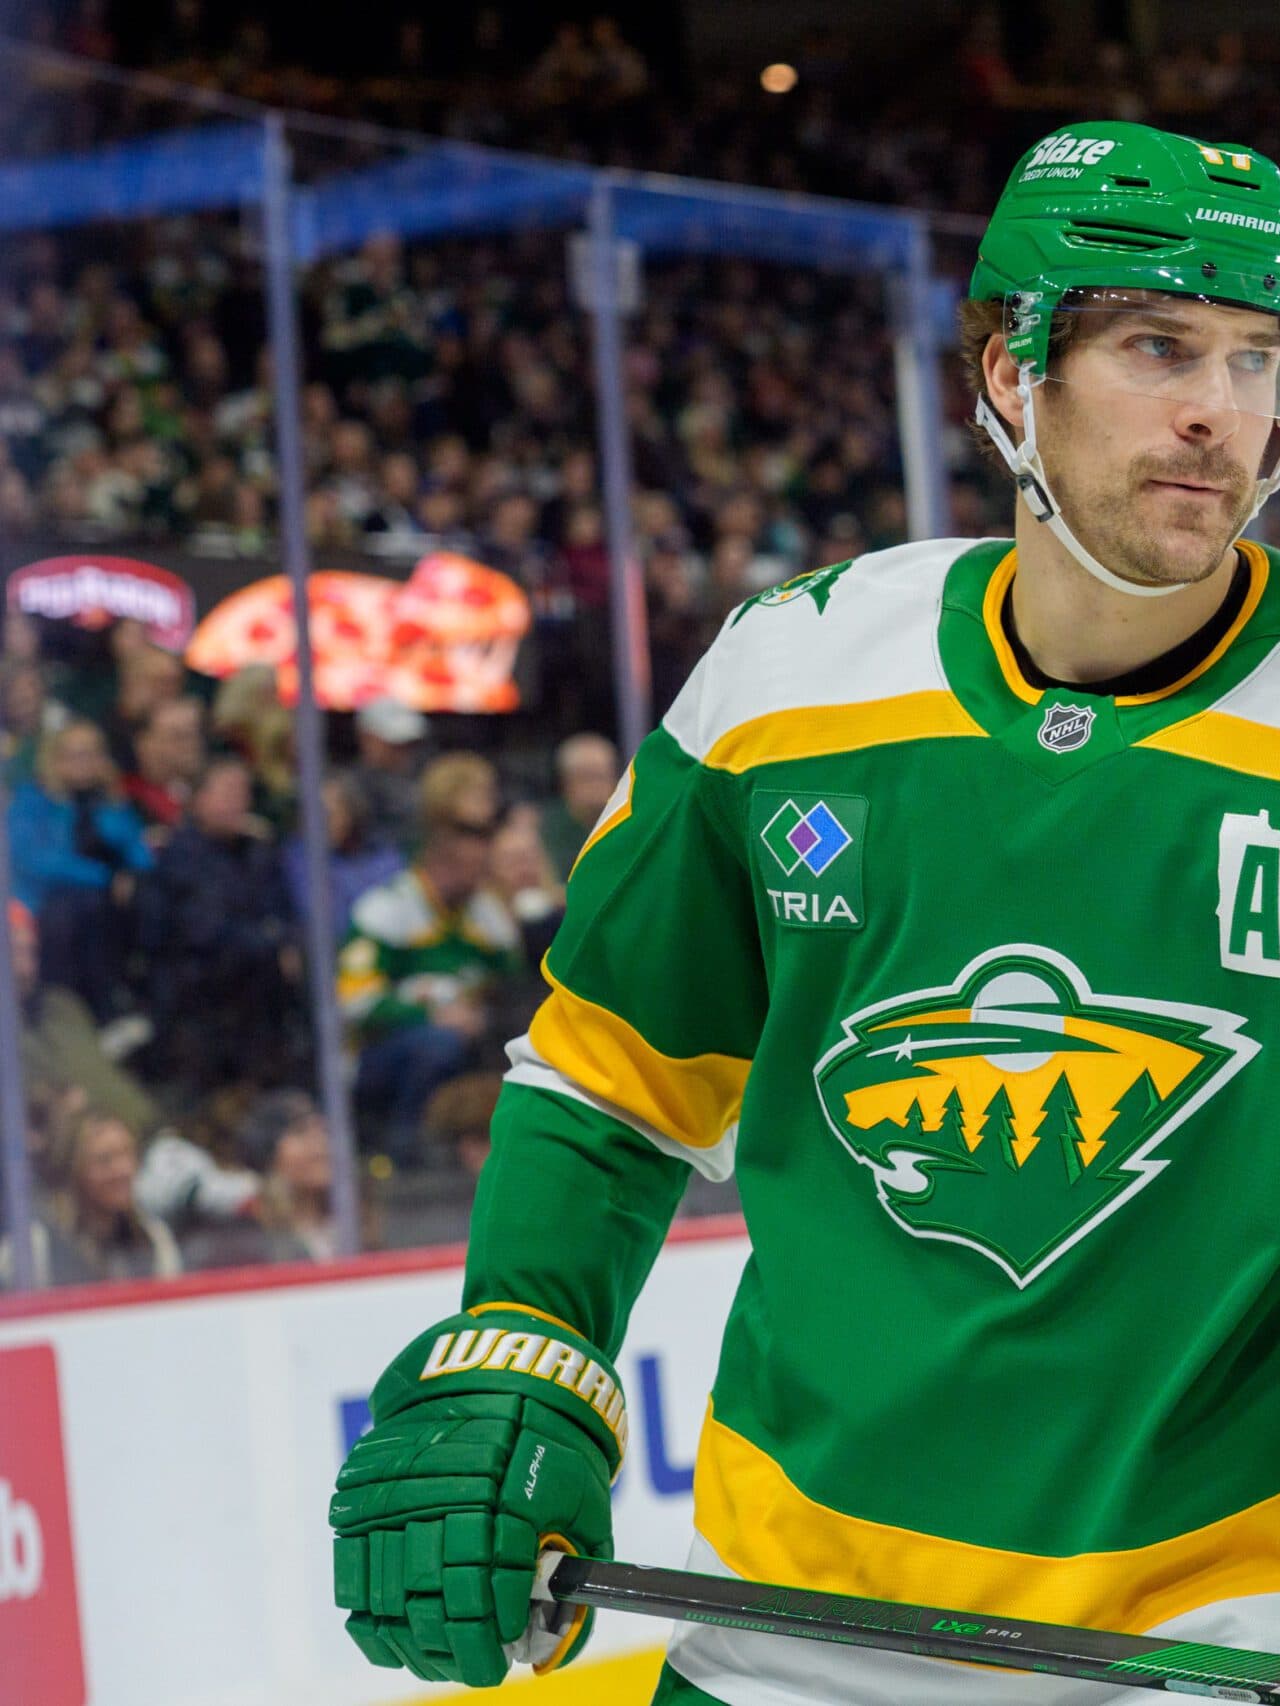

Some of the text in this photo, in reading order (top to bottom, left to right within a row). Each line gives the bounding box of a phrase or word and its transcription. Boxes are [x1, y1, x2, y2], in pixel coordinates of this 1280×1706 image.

[1046, 167, 1084, 179] UNION
[1048, 718, 1084, 741] NHL
[766, 888, 859, 924] TRIA
[1228, 843, 1280, 961] A
[523, 1444, 546, 1500] ALPHA
[985, 1628, 1023, 1640] PRO
